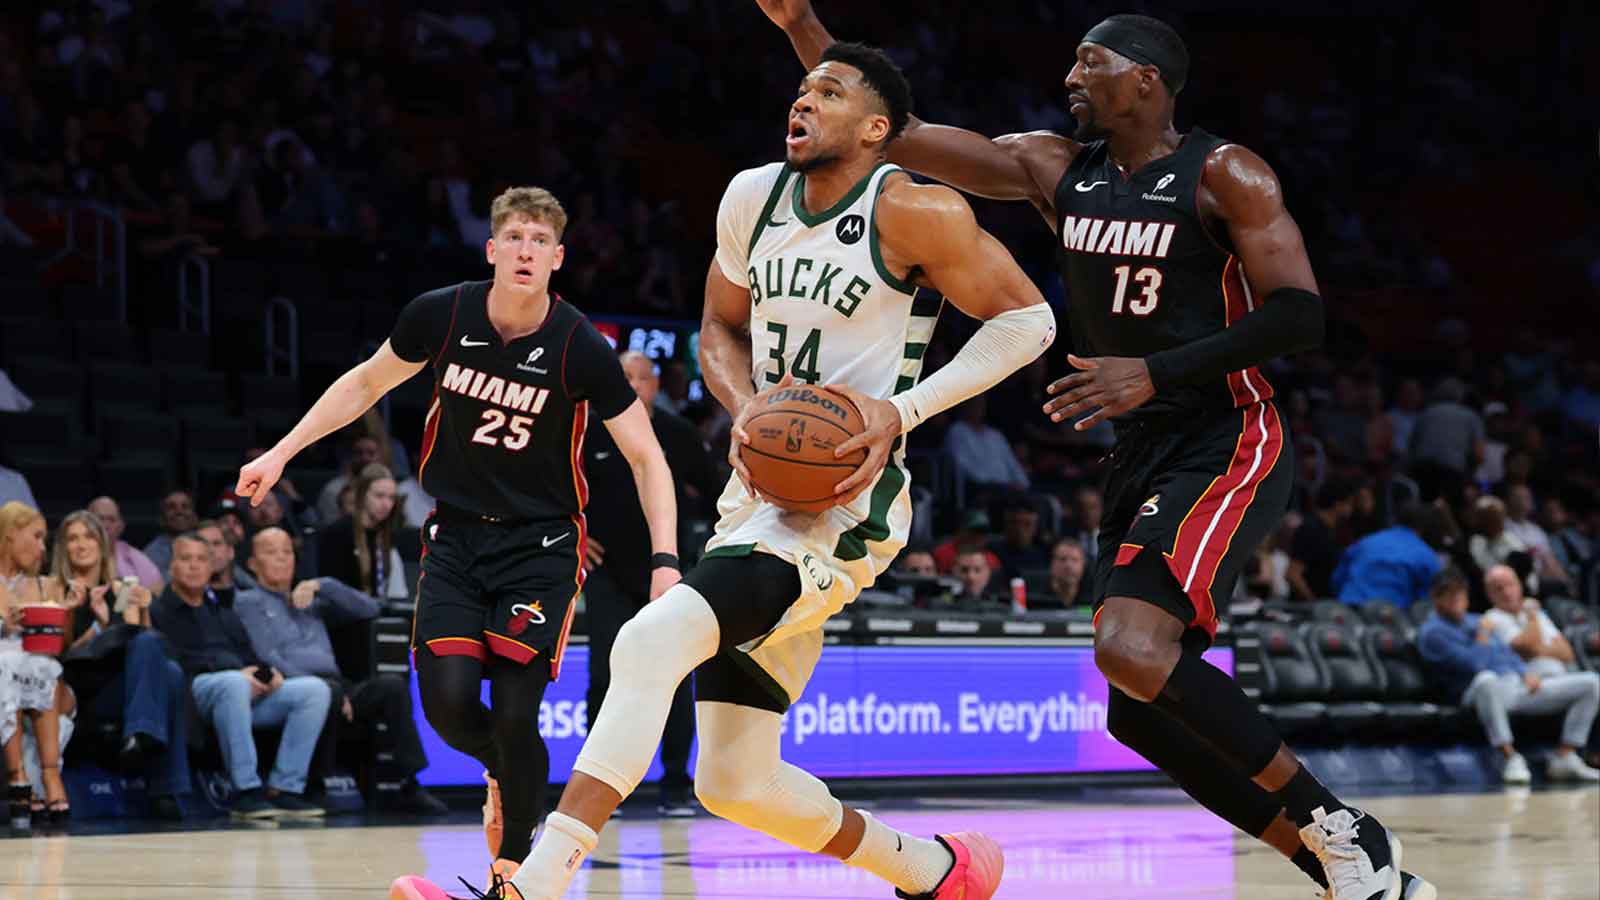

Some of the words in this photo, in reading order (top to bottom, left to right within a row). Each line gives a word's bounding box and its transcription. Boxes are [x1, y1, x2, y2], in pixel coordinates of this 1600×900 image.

[1142, 192, 1177, 203] Robinhood
[1062, 215, 1176, 258] MIAMI
[748, 257, 872, 319] BUCKS
[1111, 265, 1163, 315] 13
[765, 320, 822, 386] 34
[441, 362, 551, 415] MIAMI
[471, 408, 535, 451] 25
[794, 692, 952, 744] platform.
